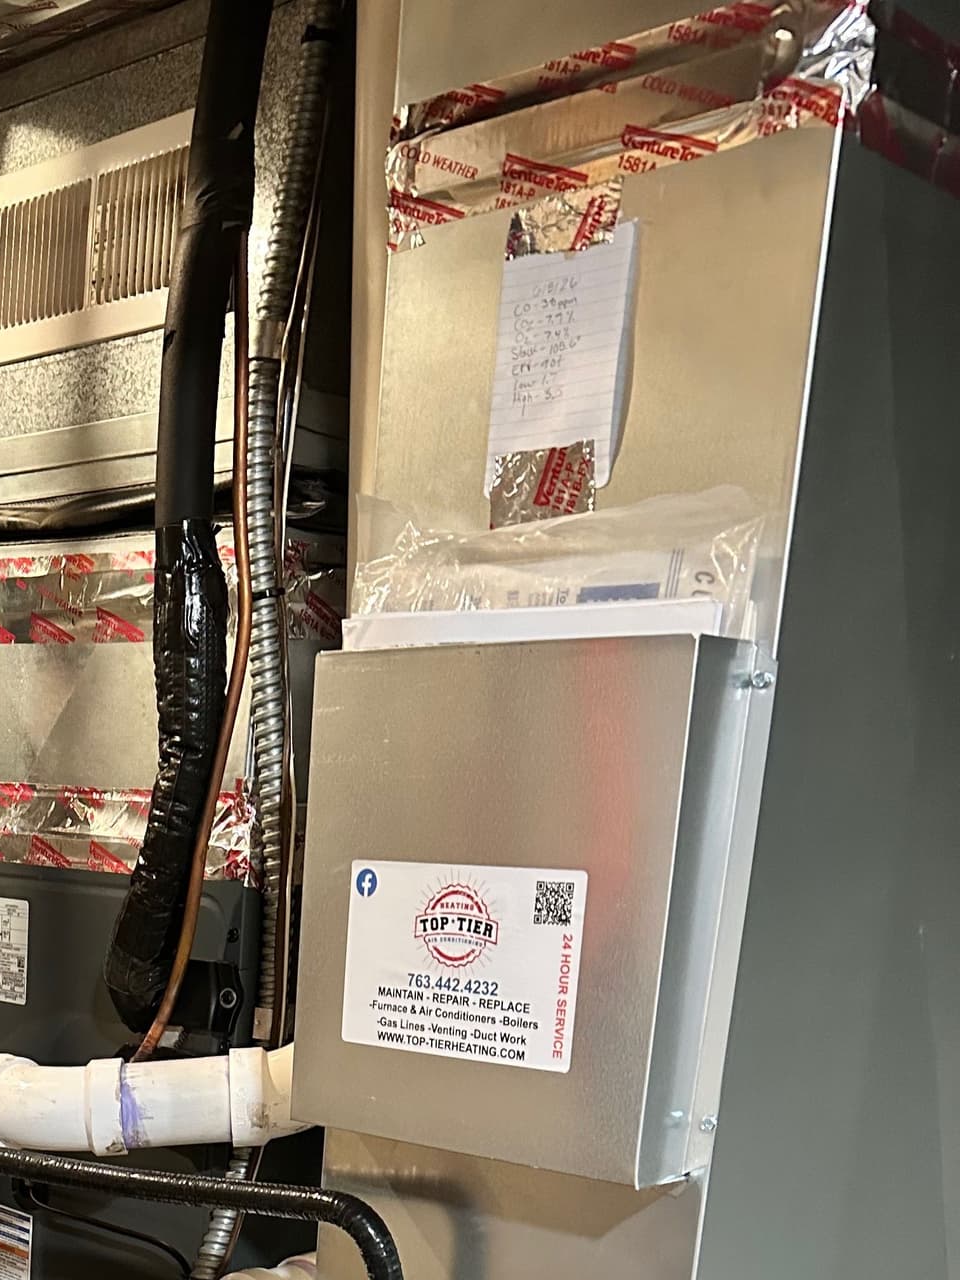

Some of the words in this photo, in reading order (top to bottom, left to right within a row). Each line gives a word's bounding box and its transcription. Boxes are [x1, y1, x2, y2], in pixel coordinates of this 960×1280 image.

[400, 144, 430, 164] COLD
[432, 154, 479, 180] WEATHER
[440, 902, 475, 911] HEATING
[562, 934, 573, 950] 24
[408, 973, 499, 996] 763.442.4232
[558, 954, 571, 995] HOUR
[378, 986, 424, 1001] MAINTAIN
[432, 993, 470, 1007] REPAIR
[478, 999, 531, 1014] REPLACE
[419, 1006, 433, 1017] Air
[435, 1008, 496, 1025] Conditioners
[552, 999, 567, 1060] SERVICE
[377, 1030, 526, 1061] WWW.TOP-TIERHEATING.COM
[400, 1018, 425, 1032] Lines
[499, 1032, 527, 1046] Work
